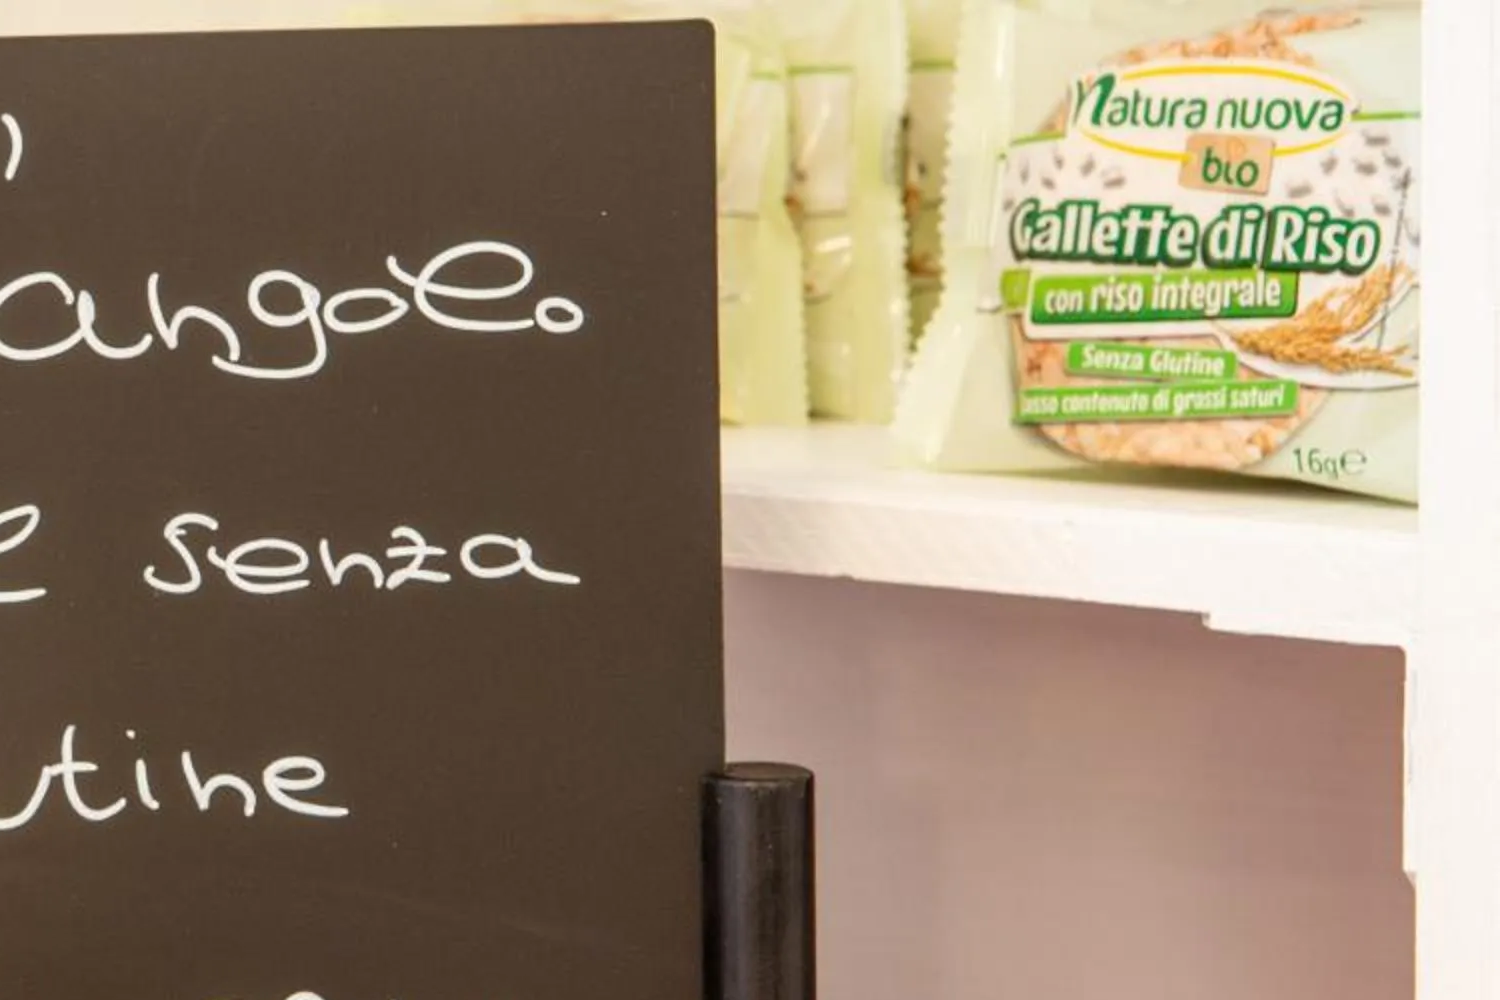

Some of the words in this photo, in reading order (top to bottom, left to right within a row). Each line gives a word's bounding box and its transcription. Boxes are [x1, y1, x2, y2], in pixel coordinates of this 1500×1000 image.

[1073, 74, 1208, 128] Natura
[1216, 99, 1345, 131] nuova
[1202, 146, 1259, 187] bio
[1204, 204, 1264, 268] di
[1268, 207, 1380, 276] Riso
[1045, 284, 1083, 312] con
[1090, 276, 1143, 312] riso
[1151, 273, 1281, 315] integrale
[1081, 344, 1143, 371] Senza
[1149, 350, 1225, 377] Glutine
[1061, 389, 1148, 413] contenuto
[1152, 383, 1170, 406] di
[1230, 382, 1286, 407] saturi
[143, 512, 581, 595] senza
